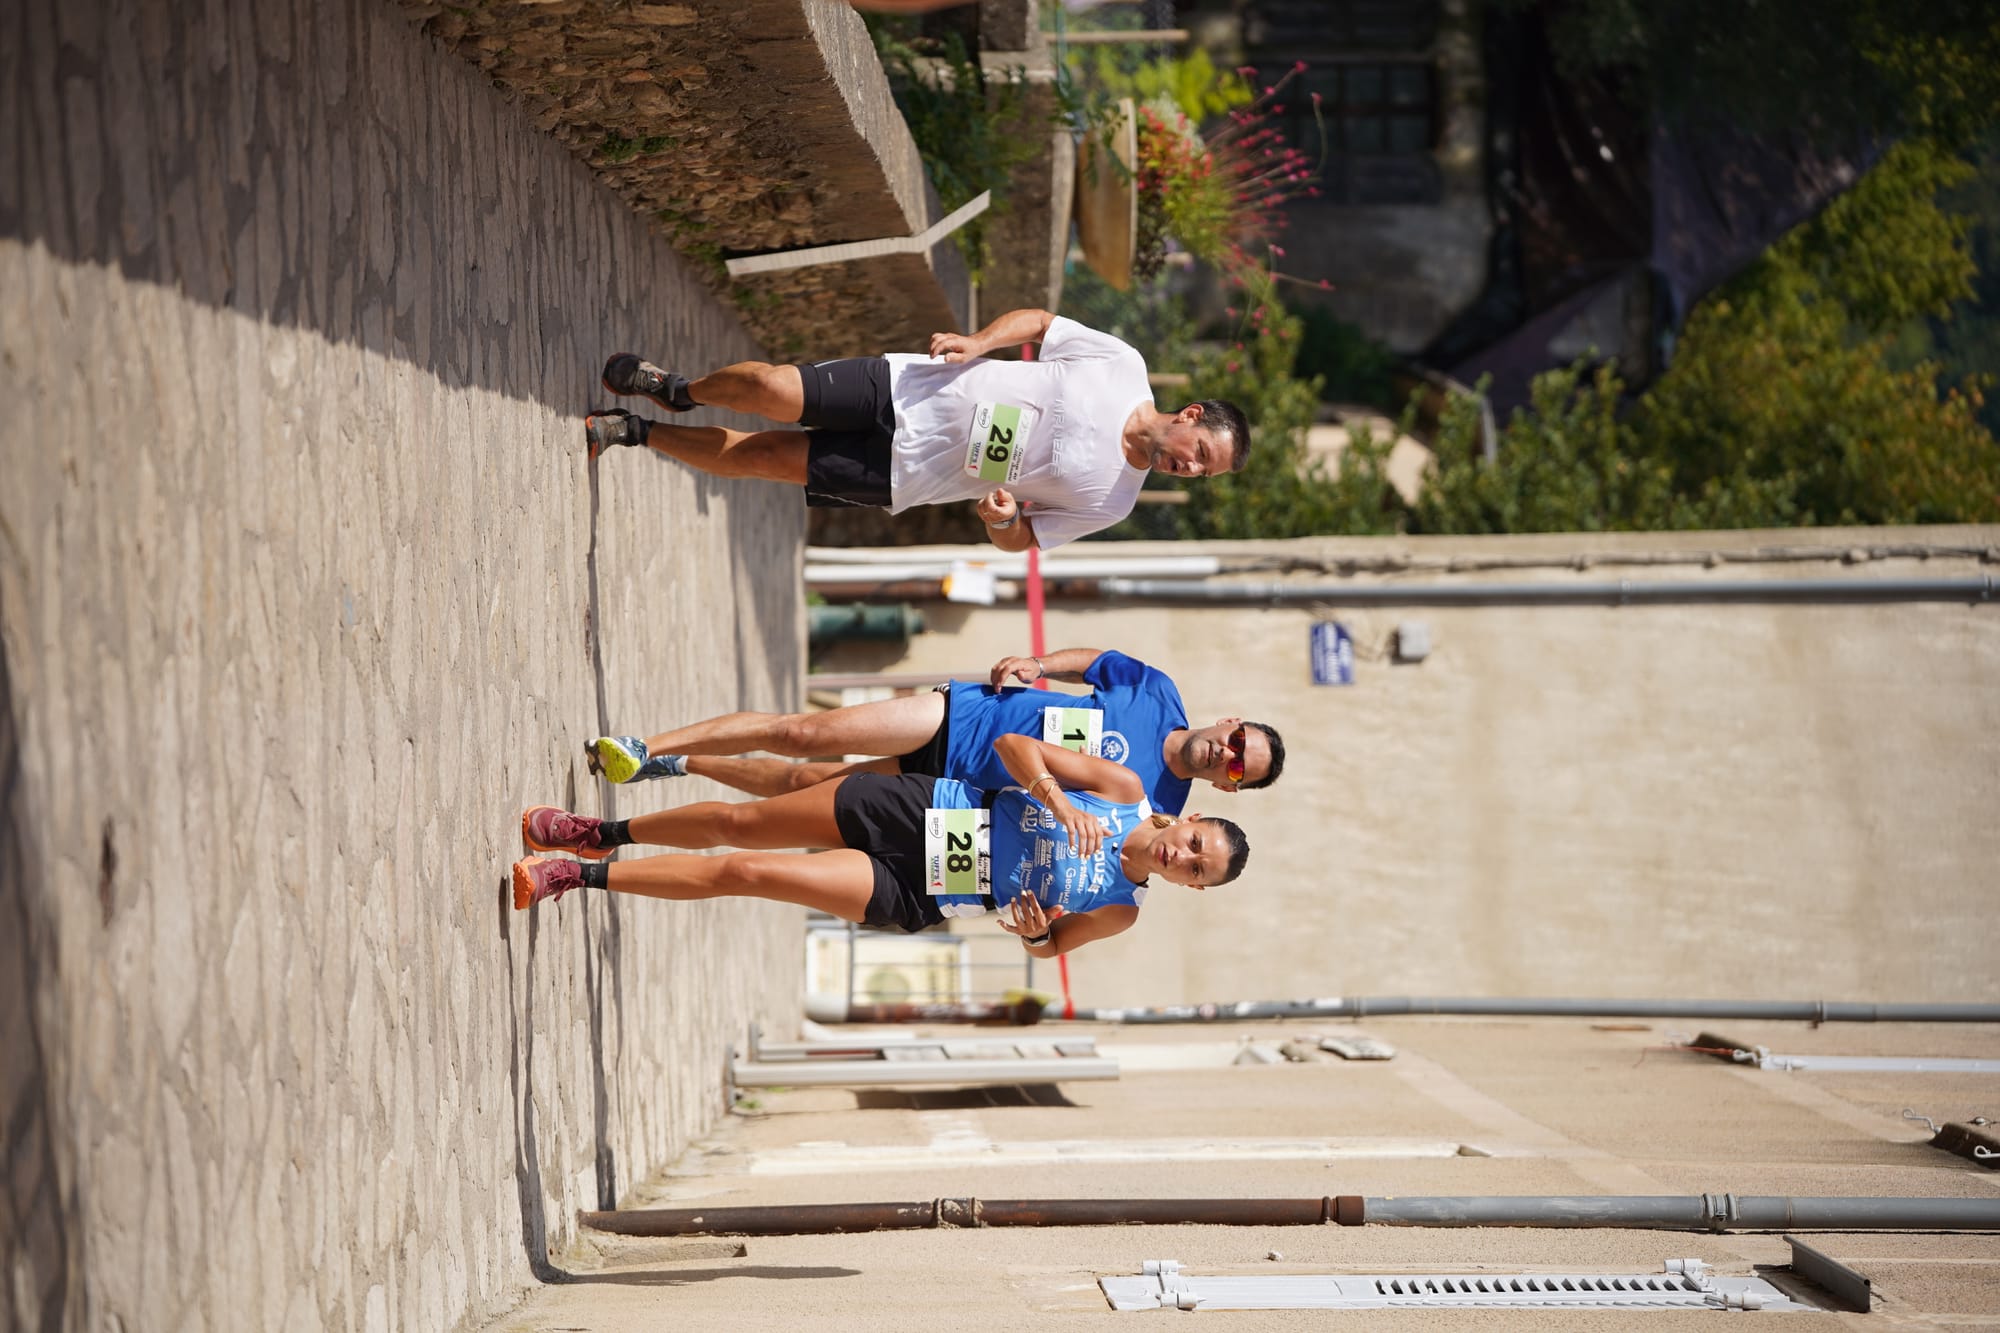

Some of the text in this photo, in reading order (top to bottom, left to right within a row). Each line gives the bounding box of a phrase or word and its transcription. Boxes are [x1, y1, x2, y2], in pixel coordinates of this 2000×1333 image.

[986, 424, 1012, 462] 29
[1063, 728, 1086, 740] 1
[947, 832, 972, 873] 28
